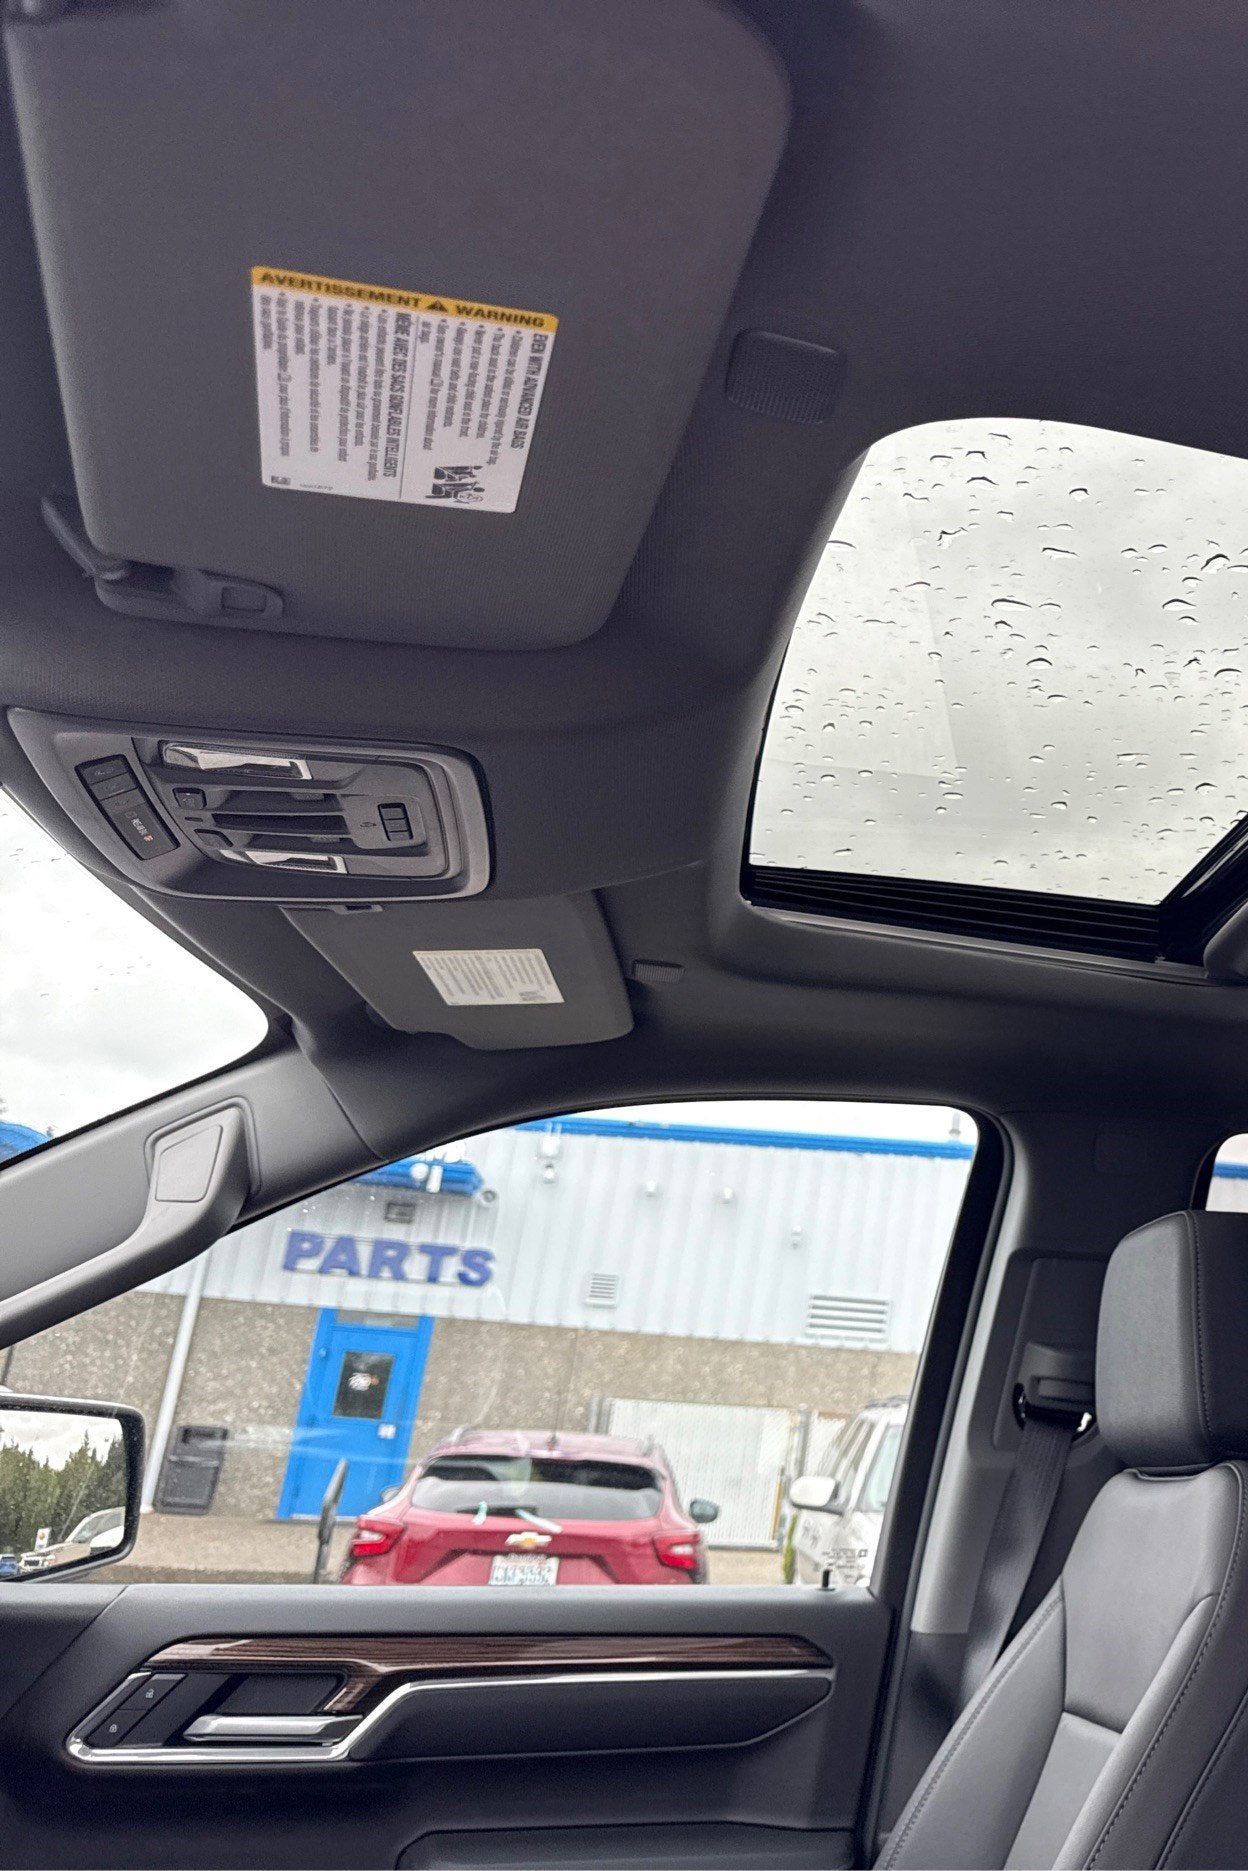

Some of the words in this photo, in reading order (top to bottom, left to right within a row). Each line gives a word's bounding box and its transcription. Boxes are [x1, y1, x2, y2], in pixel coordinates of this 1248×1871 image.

[259, 271, 421, 309] AVERTISSEMENT
[455, 303, 546, 328] WARNING
[529, 332, 548, 355] EVEN
[283, 1230, 496, 1287] PARTS
